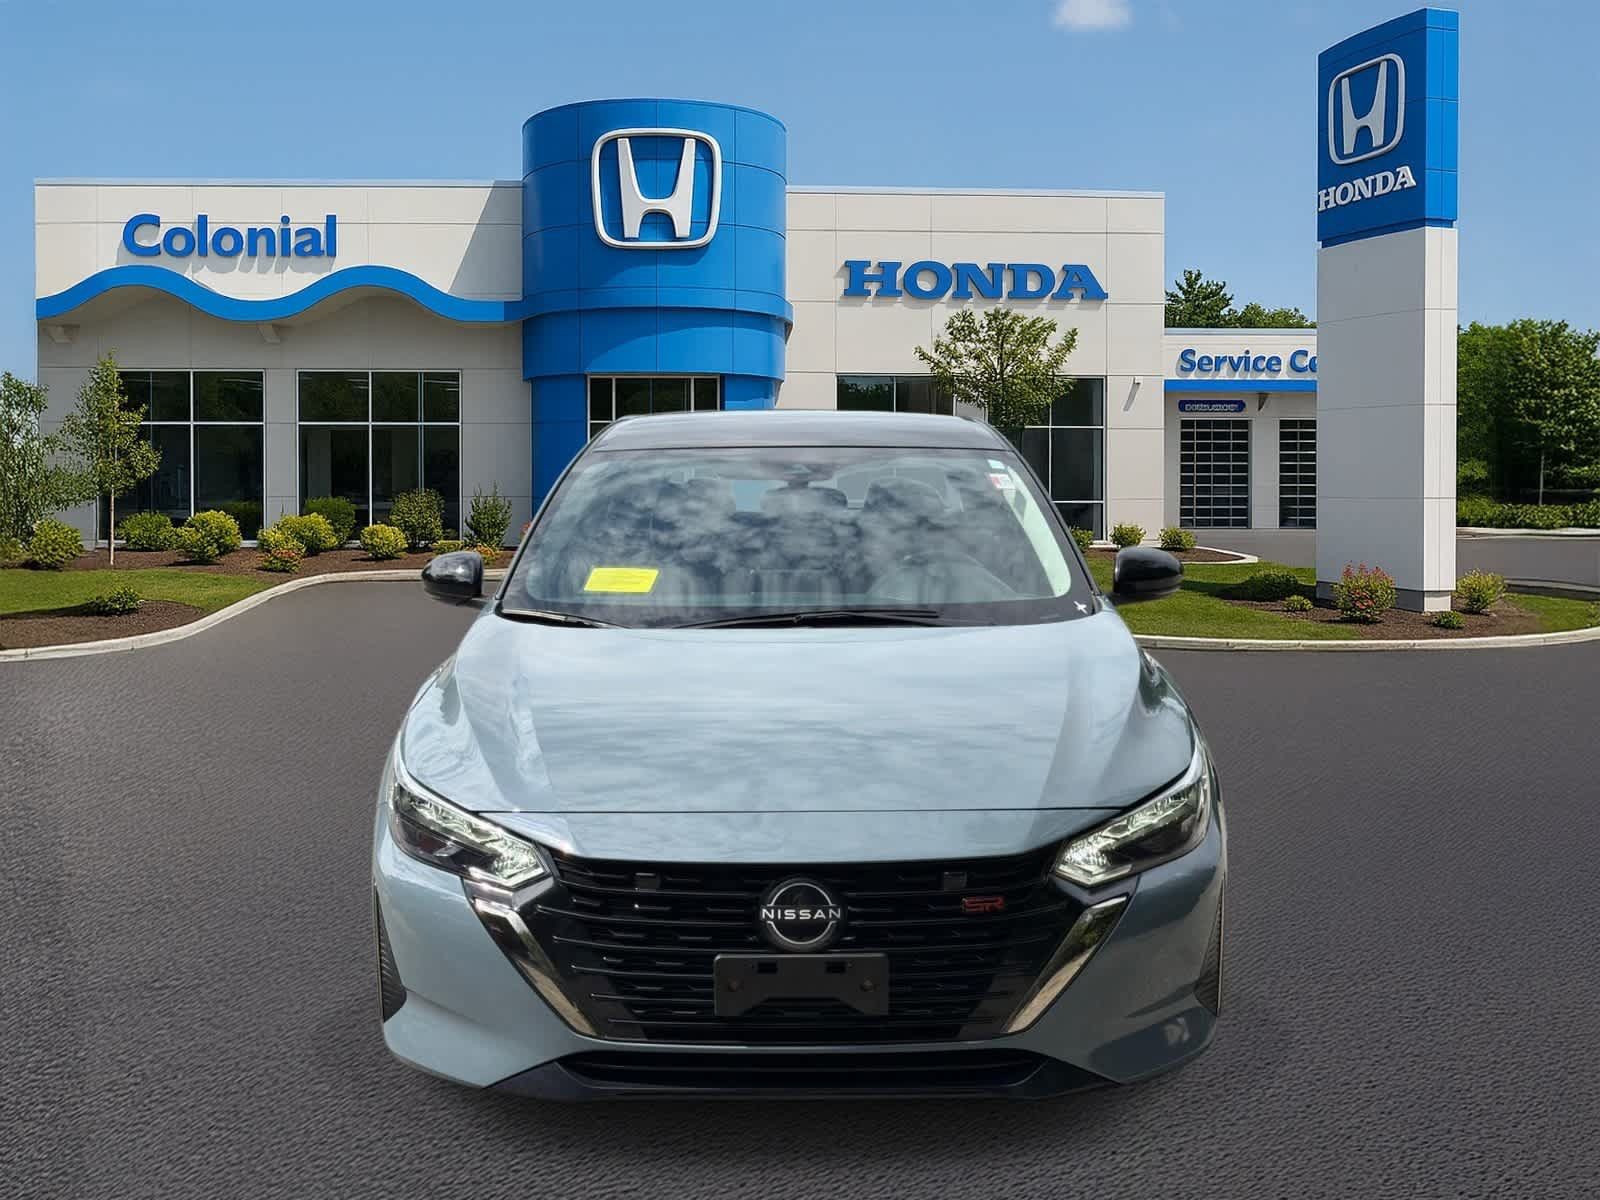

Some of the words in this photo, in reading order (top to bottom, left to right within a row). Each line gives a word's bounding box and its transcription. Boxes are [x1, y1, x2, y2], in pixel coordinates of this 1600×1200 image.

[1318, 165, 1416, 211] HONDA
[123, 213, 337, 257] Colonial
[843, 260, 1109, 300] HONDA
[1180, 349, 1282, 372] Service
[760, 907, 841, 920] NISSAN
